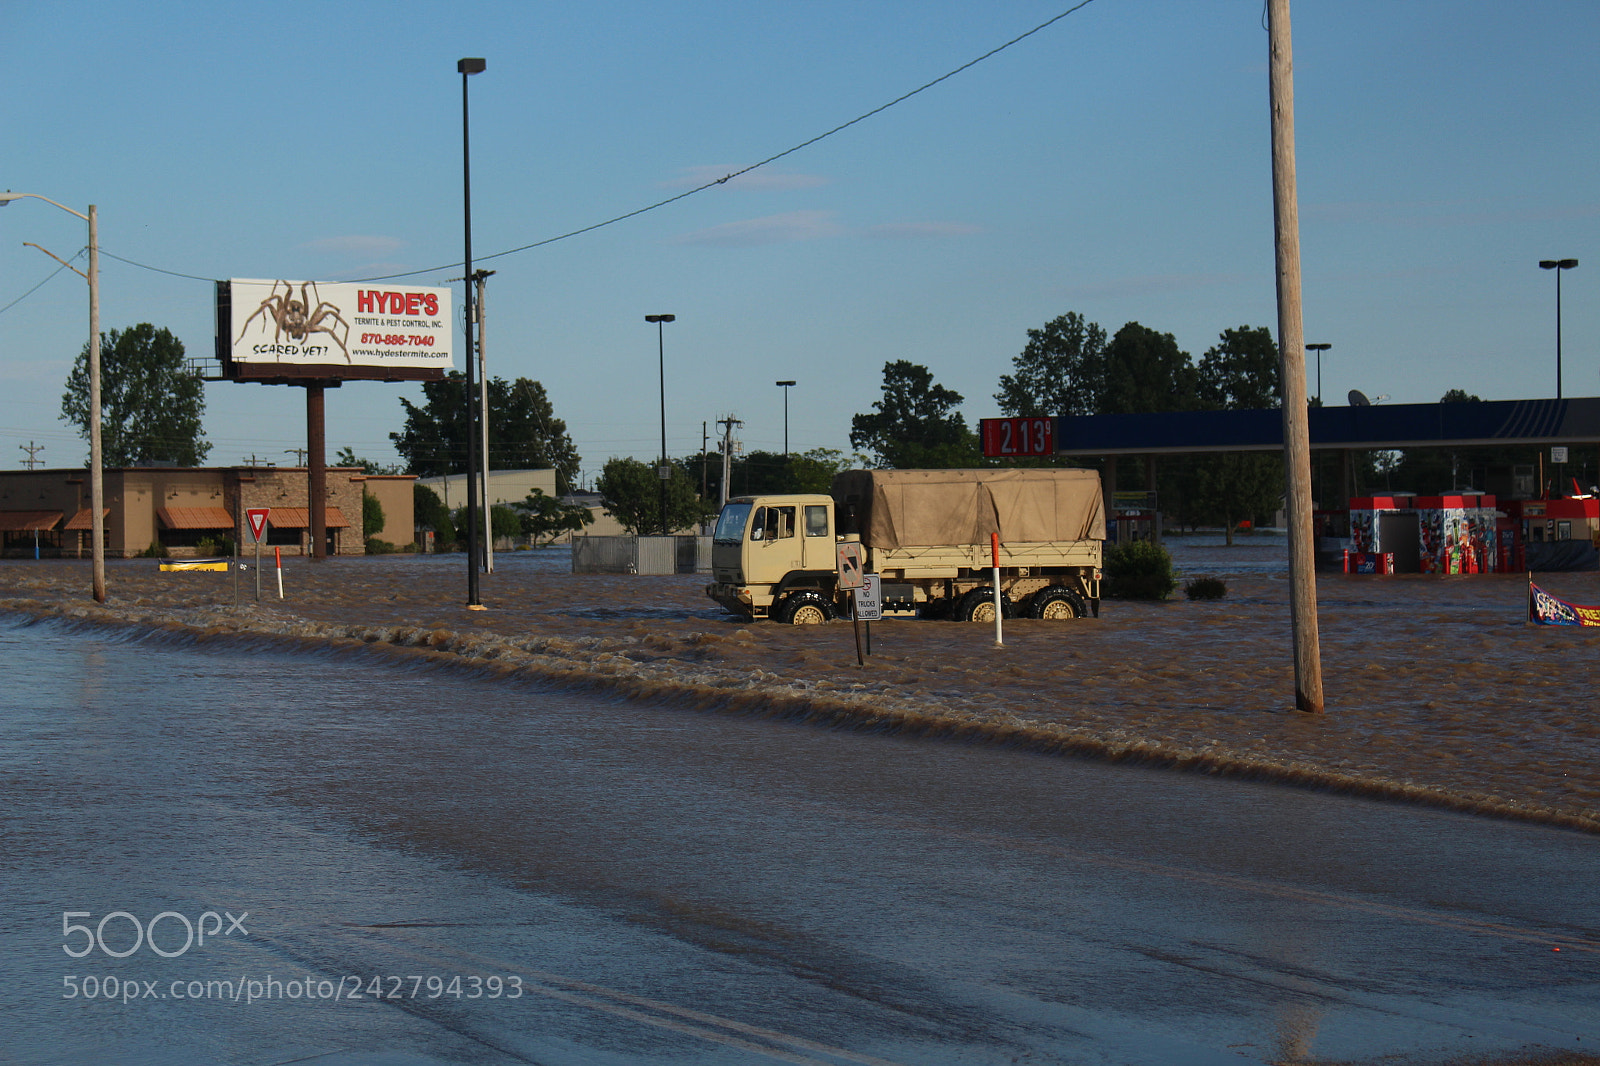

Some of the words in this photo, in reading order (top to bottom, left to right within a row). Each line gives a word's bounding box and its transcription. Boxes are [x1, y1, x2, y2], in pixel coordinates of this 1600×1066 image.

[357, 290, 439, 316] HYDE'S
[354, 317, 379, 326] TERMITE
[380, 318, 385, 326] &
[386, 319, 401, 327] PEST
[402, 320, 431, 329] CONTROL,
[431, 320, 443, 328] INC.
[253, 344, 299, 356] SCARED
[302, 346, 328, 357] YET?
[352, 349, 448, 359] www.hydestermite.com
